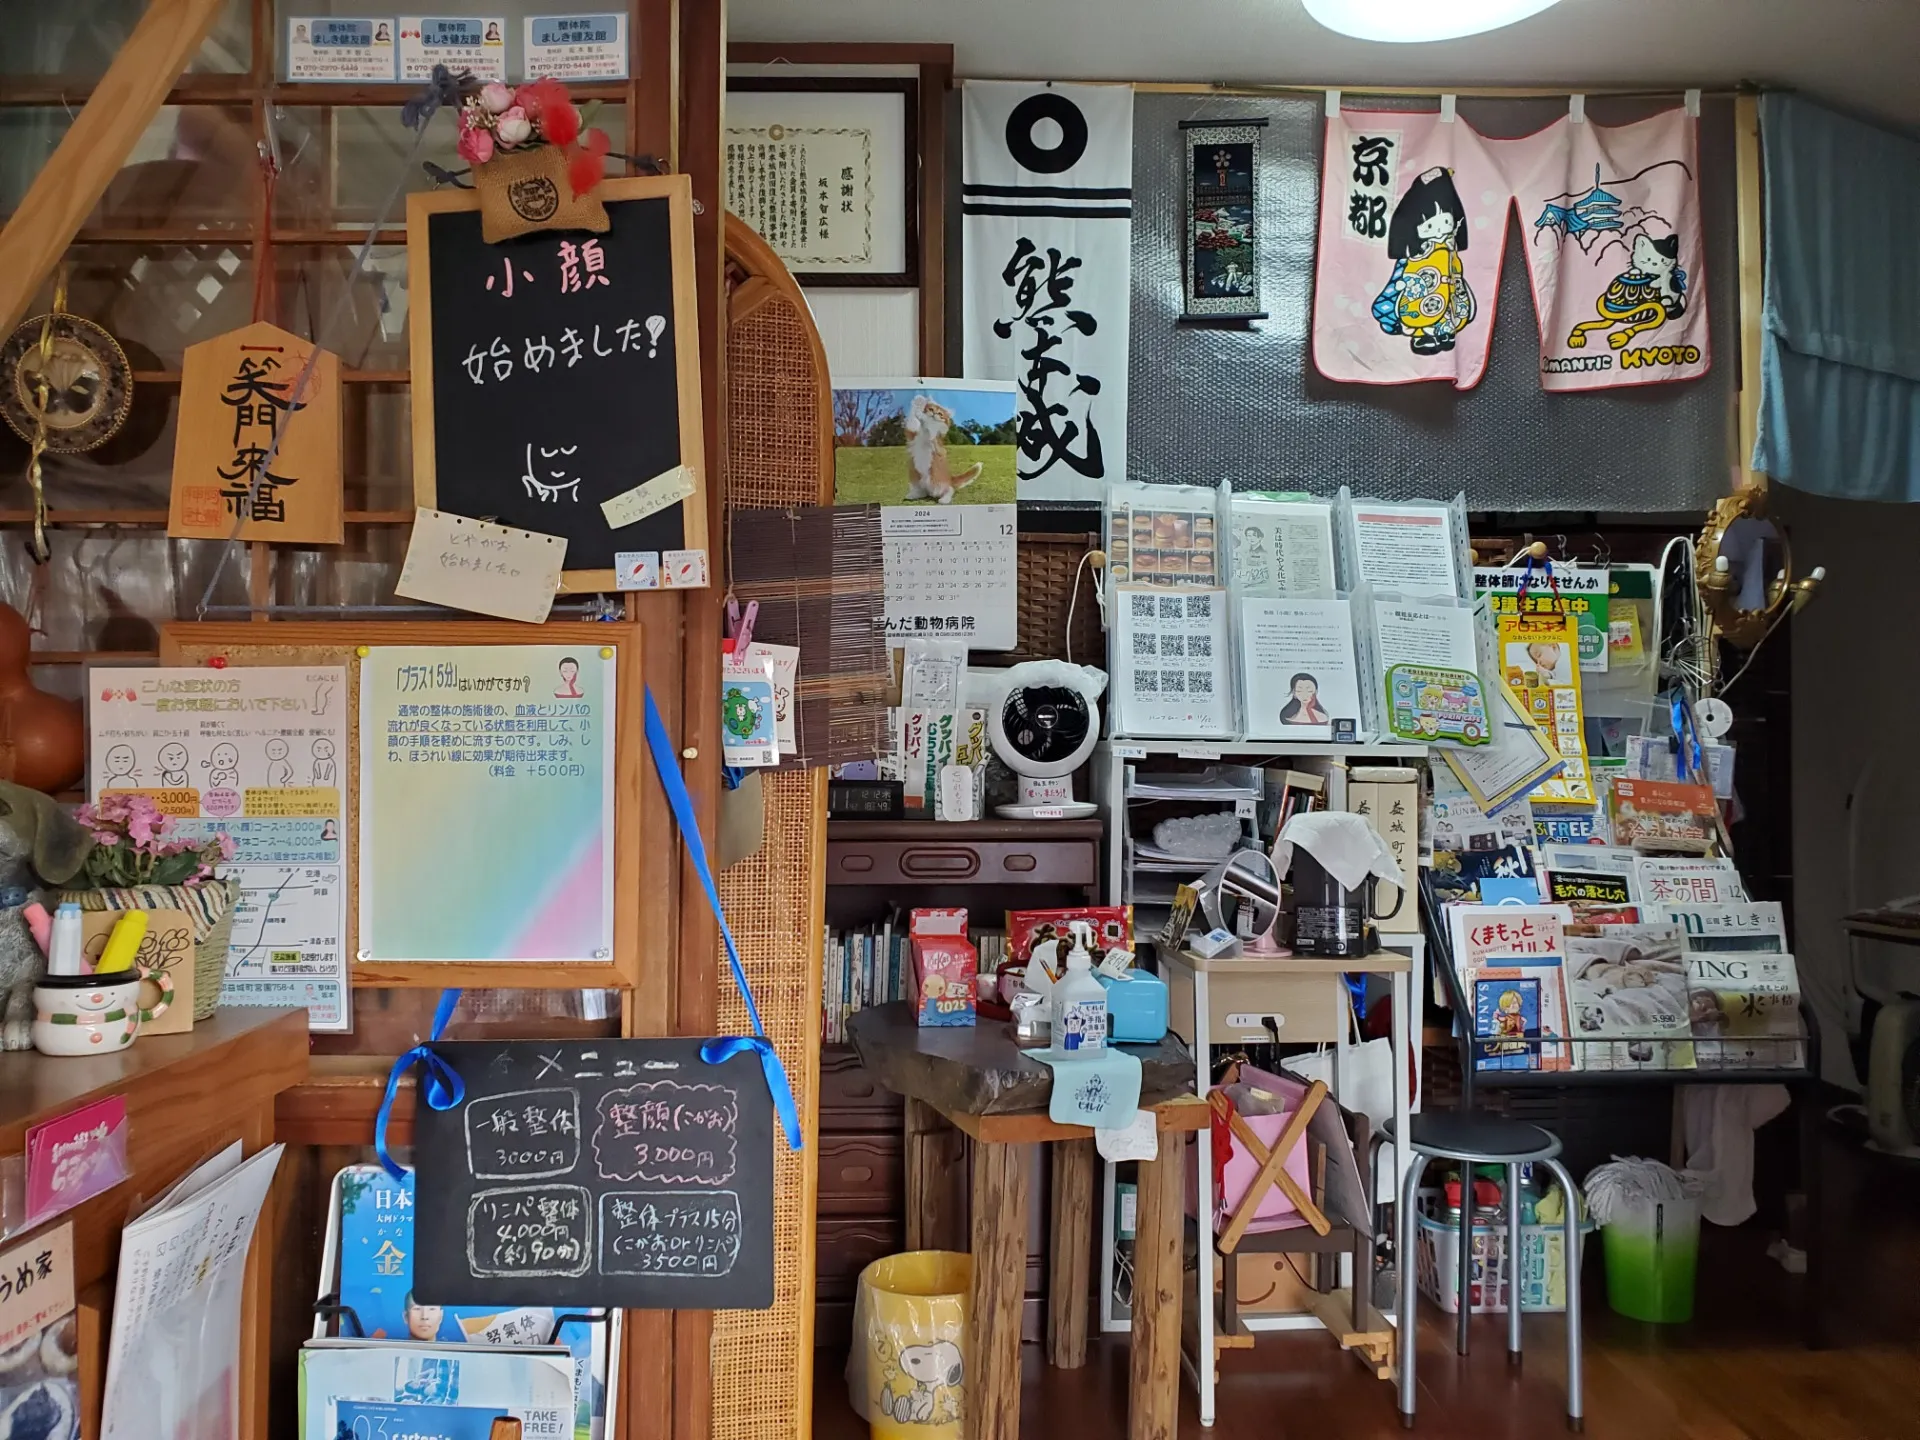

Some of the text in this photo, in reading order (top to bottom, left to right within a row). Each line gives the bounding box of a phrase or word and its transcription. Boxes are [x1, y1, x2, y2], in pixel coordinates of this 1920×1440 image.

[424, 34, 481, 45] ましき健友館
[541, 31, 607, 43] ましき健友館
[840, 166, 854, 213] 感謝状
[1348, 135, 1395, 239] 京都
[485, 238, 611, 298] 小顔
[462, 314, 667, 385] 始めました!
[993, 236, 1105, 480] 熊本城
[1619, 345, 1701, 369] KYOTO
[999, 524, 1014, 535] 12
[141, 678, 241, 694] こんな症状の方
[387, 719, 591, 733] 流れが良くなっている状態を利用して、小
[387, 734, 591, 748] 顔の手順を軽めに流すものです。しみ、し
[911, 713, 923, 759] グッバイ
[305, 869, 321, 878] 空港
[1553, 884, 1626, 903] 毛穴の落とし穴
[1649, 877, 1719, 903] 茶の間
[1721, 912, 1760, 927] ましき
[1470, 917, 1535, 947] くまもっと
[936, 999, 967, 1013] 2025
[1478, 983, 1490, 1032] SANJI
[534, 1049, 680, 1080] メニュー
[475, 1103, 579, 1137] 一般整体
[496, 1149, 565, 1167] 3000円
[375, 1187, 413, 1211] 日本
[375, 1212, 413, 1225] 大河ドラマ
[371, 1239, 407, 1277] 金
[641, 1253, 719, 1271] 3500円
[523, 1410, 558, 1422] TAKE
[523, 1421, 564, 1435] FREE!
